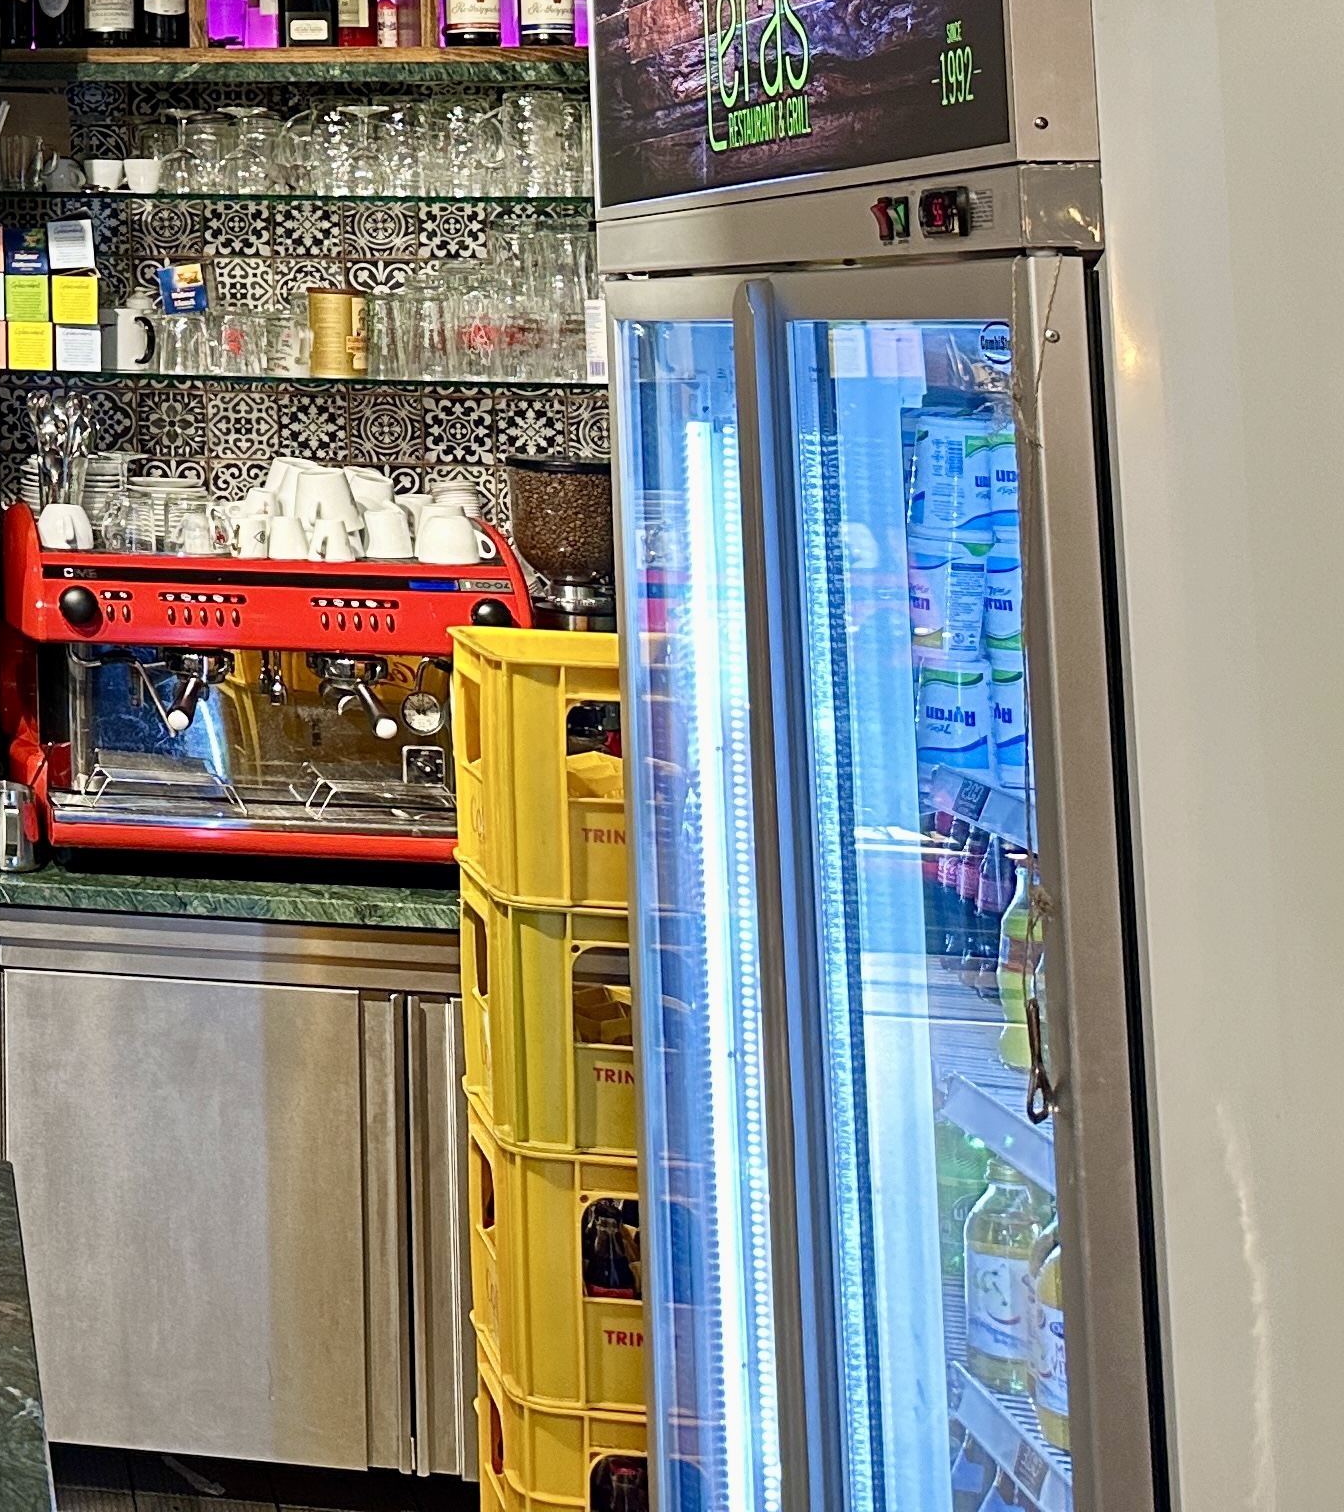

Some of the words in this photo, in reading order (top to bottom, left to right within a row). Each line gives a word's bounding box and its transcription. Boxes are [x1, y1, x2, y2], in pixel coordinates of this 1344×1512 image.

[728, 102, 777, 147] RESTAURANT
[778, 100, 785, 137] &
[786, 96, 811, 136] GRILL
